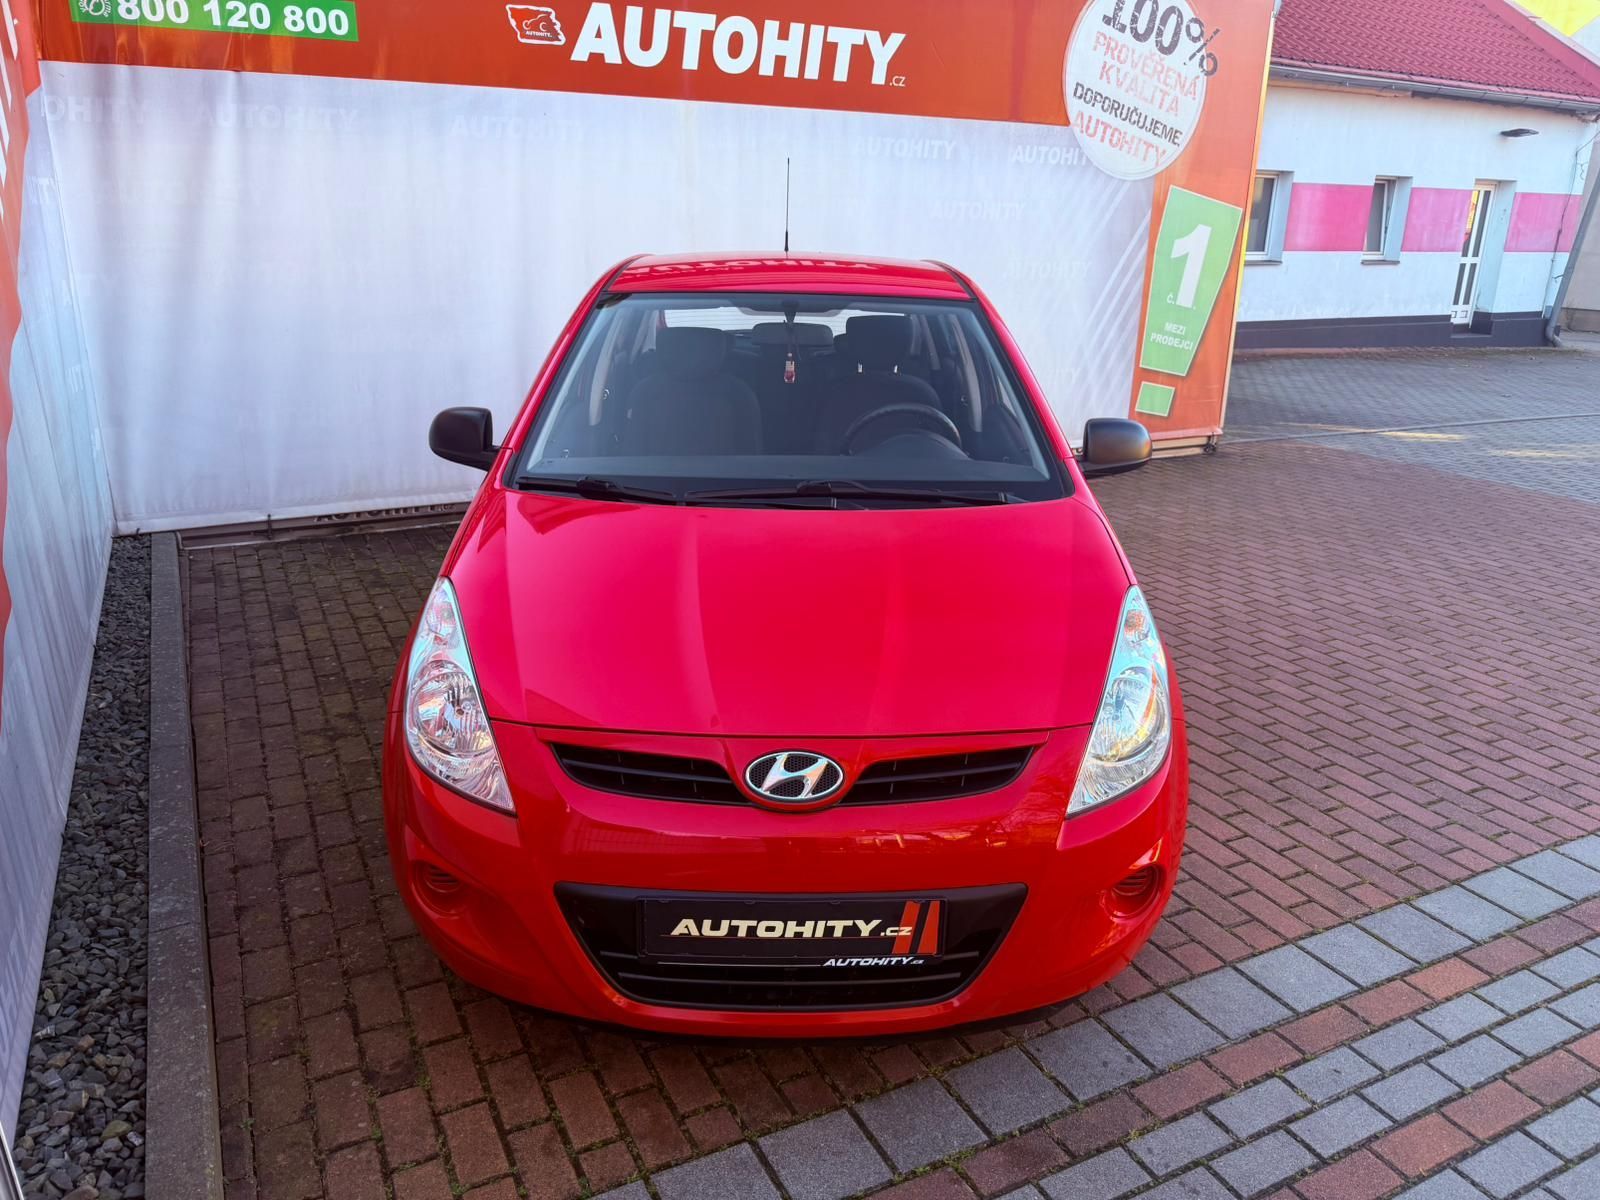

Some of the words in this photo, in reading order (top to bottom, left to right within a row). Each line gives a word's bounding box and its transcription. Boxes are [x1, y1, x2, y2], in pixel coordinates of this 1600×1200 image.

[117, 0, 189, 24] 800
[203, 0, 271, 29] 120
[283, 5, 349, 36] 800
[1101, 0, 1220, 76] 100%
[1093, 31, 1200, 100] PROVĚŘENÁ
[1099, 61, 1180, 117] KVALITA
[1072, 110, 1167, 167] AUTOHITY
[1073, 82, 1183, 147] DOPORUČUJEME
[1150, 332, 1193, 351] PRODEJCI
[1164, 322, 1187, 336] MEZI
